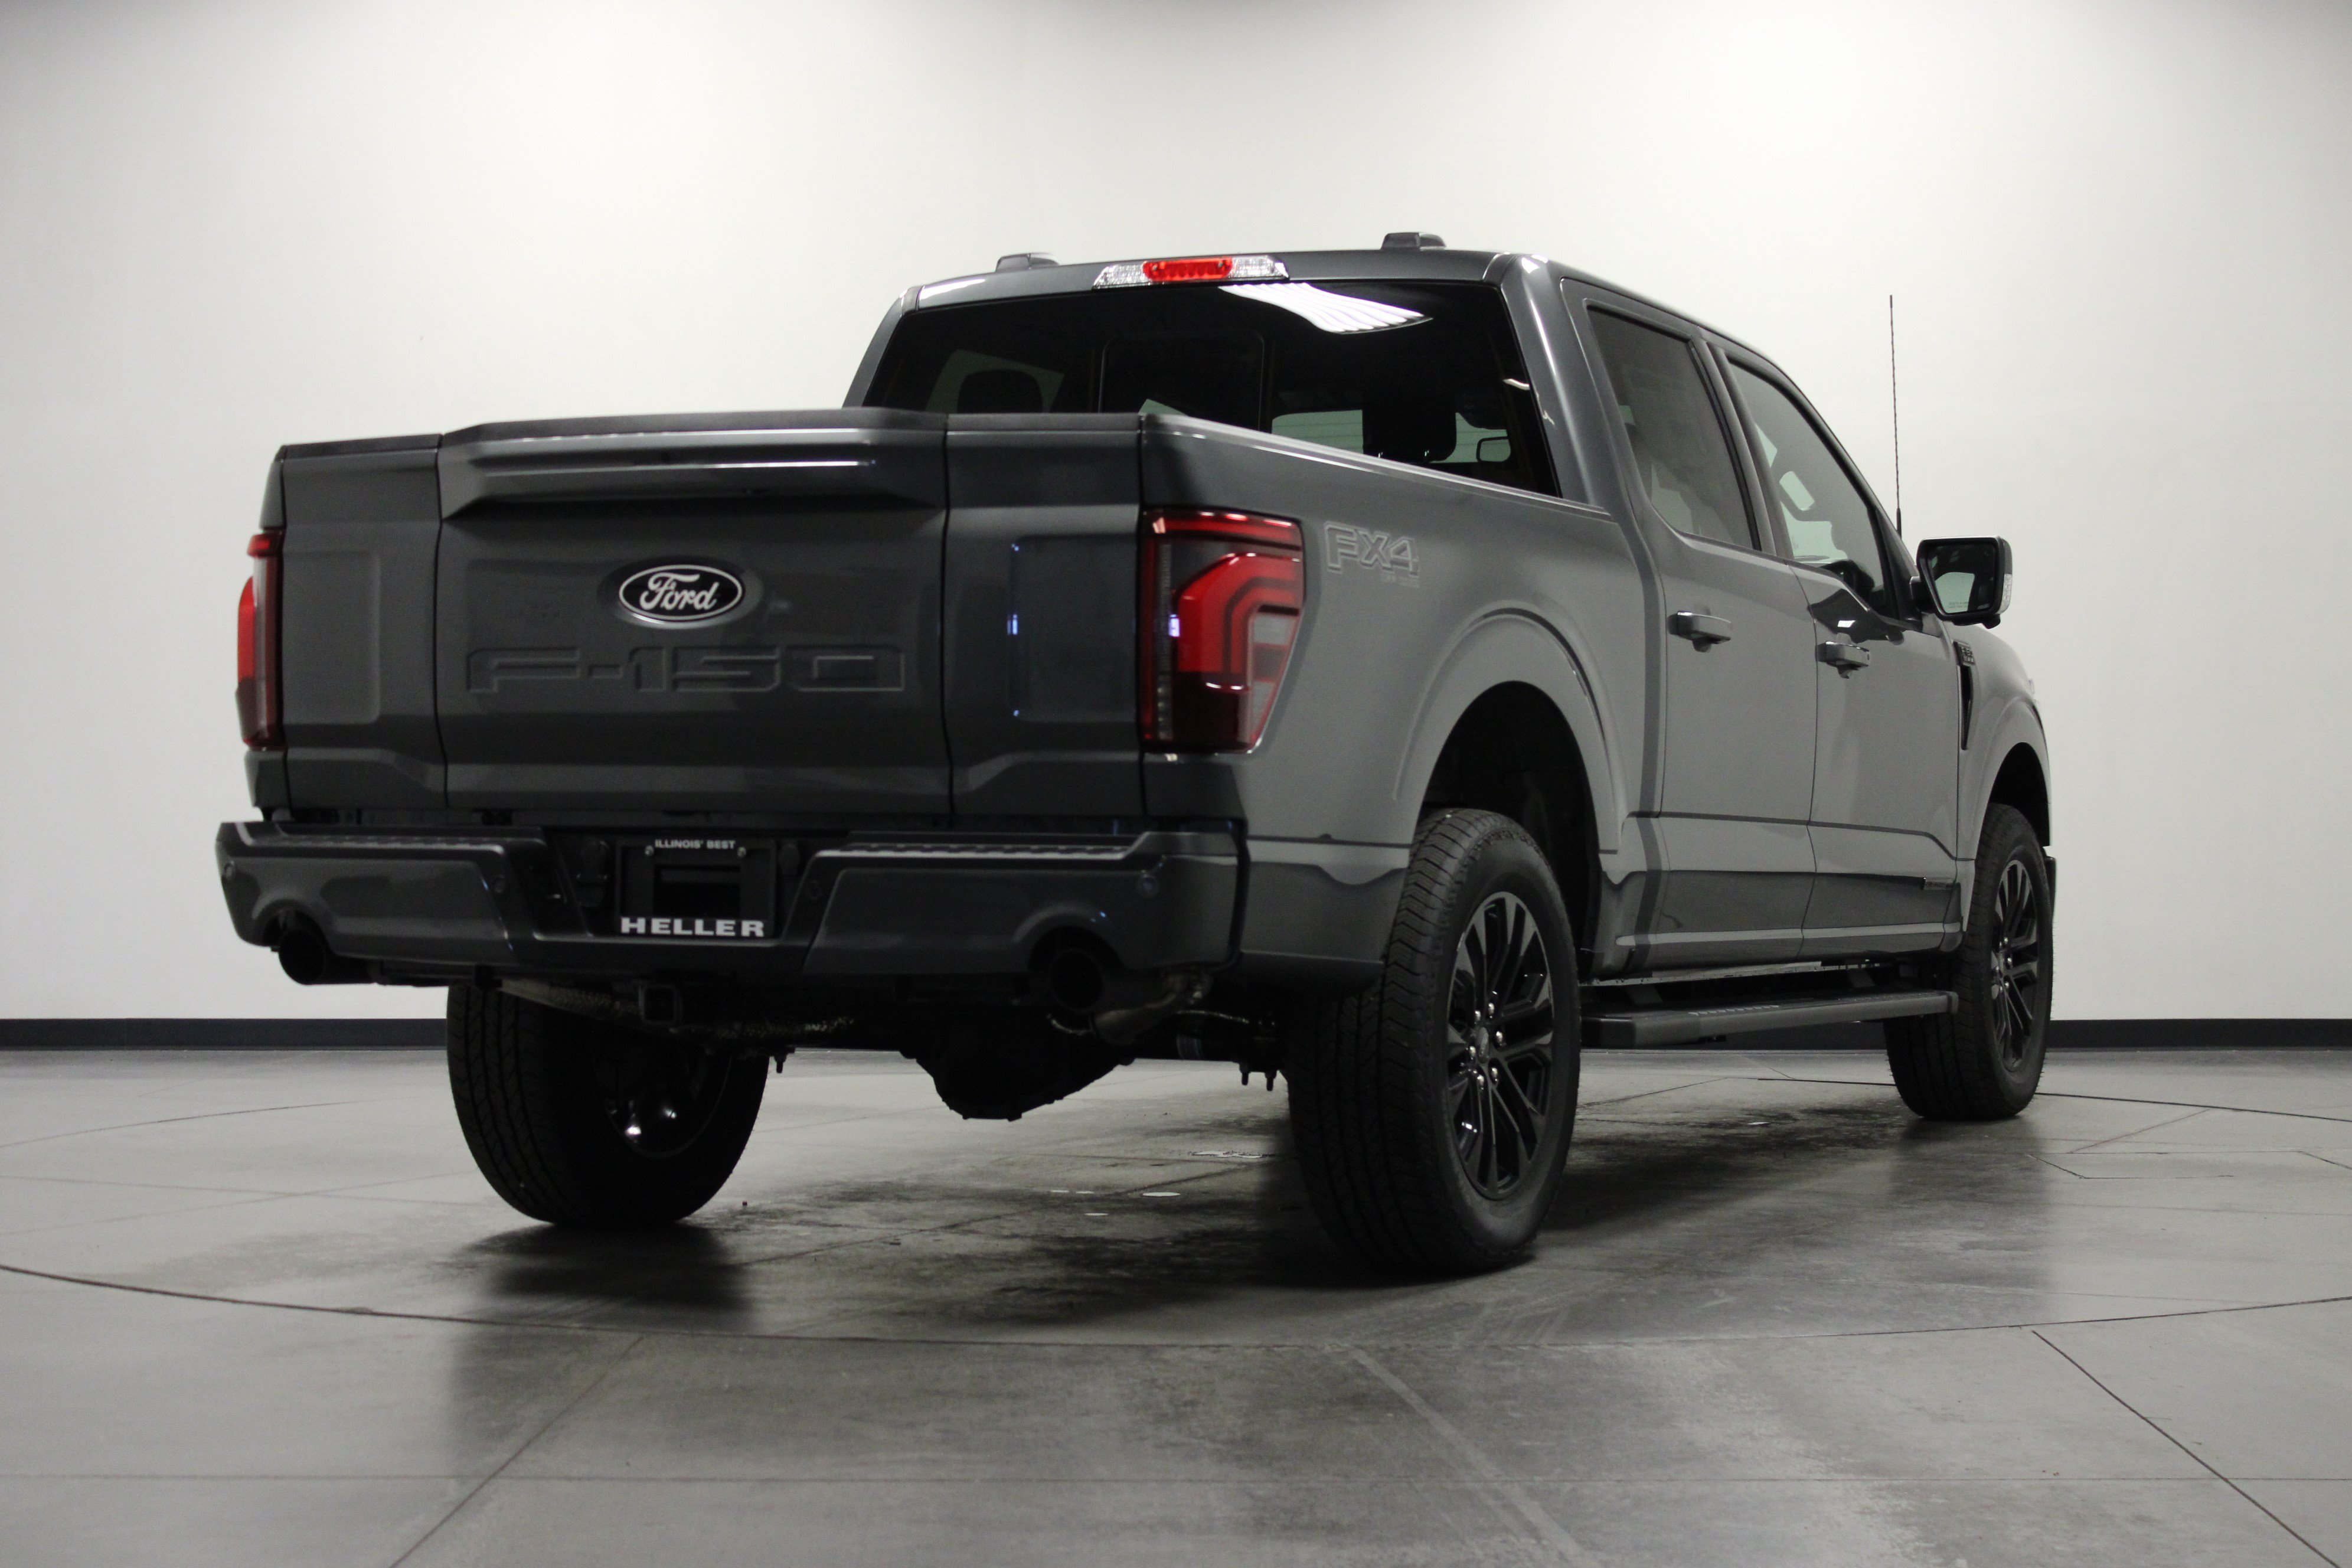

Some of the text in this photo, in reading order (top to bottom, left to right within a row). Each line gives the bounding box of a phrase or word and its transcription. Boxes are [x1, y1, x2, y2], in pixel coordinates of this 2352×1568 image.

[1325, 521, 1419, 577] FX4
[639, 571, 720, 611] Ford
[466, 643, 905, 693] F-150
[706, 839, 736, 850] BEST
[620, 917, 765, 937] HELLER
